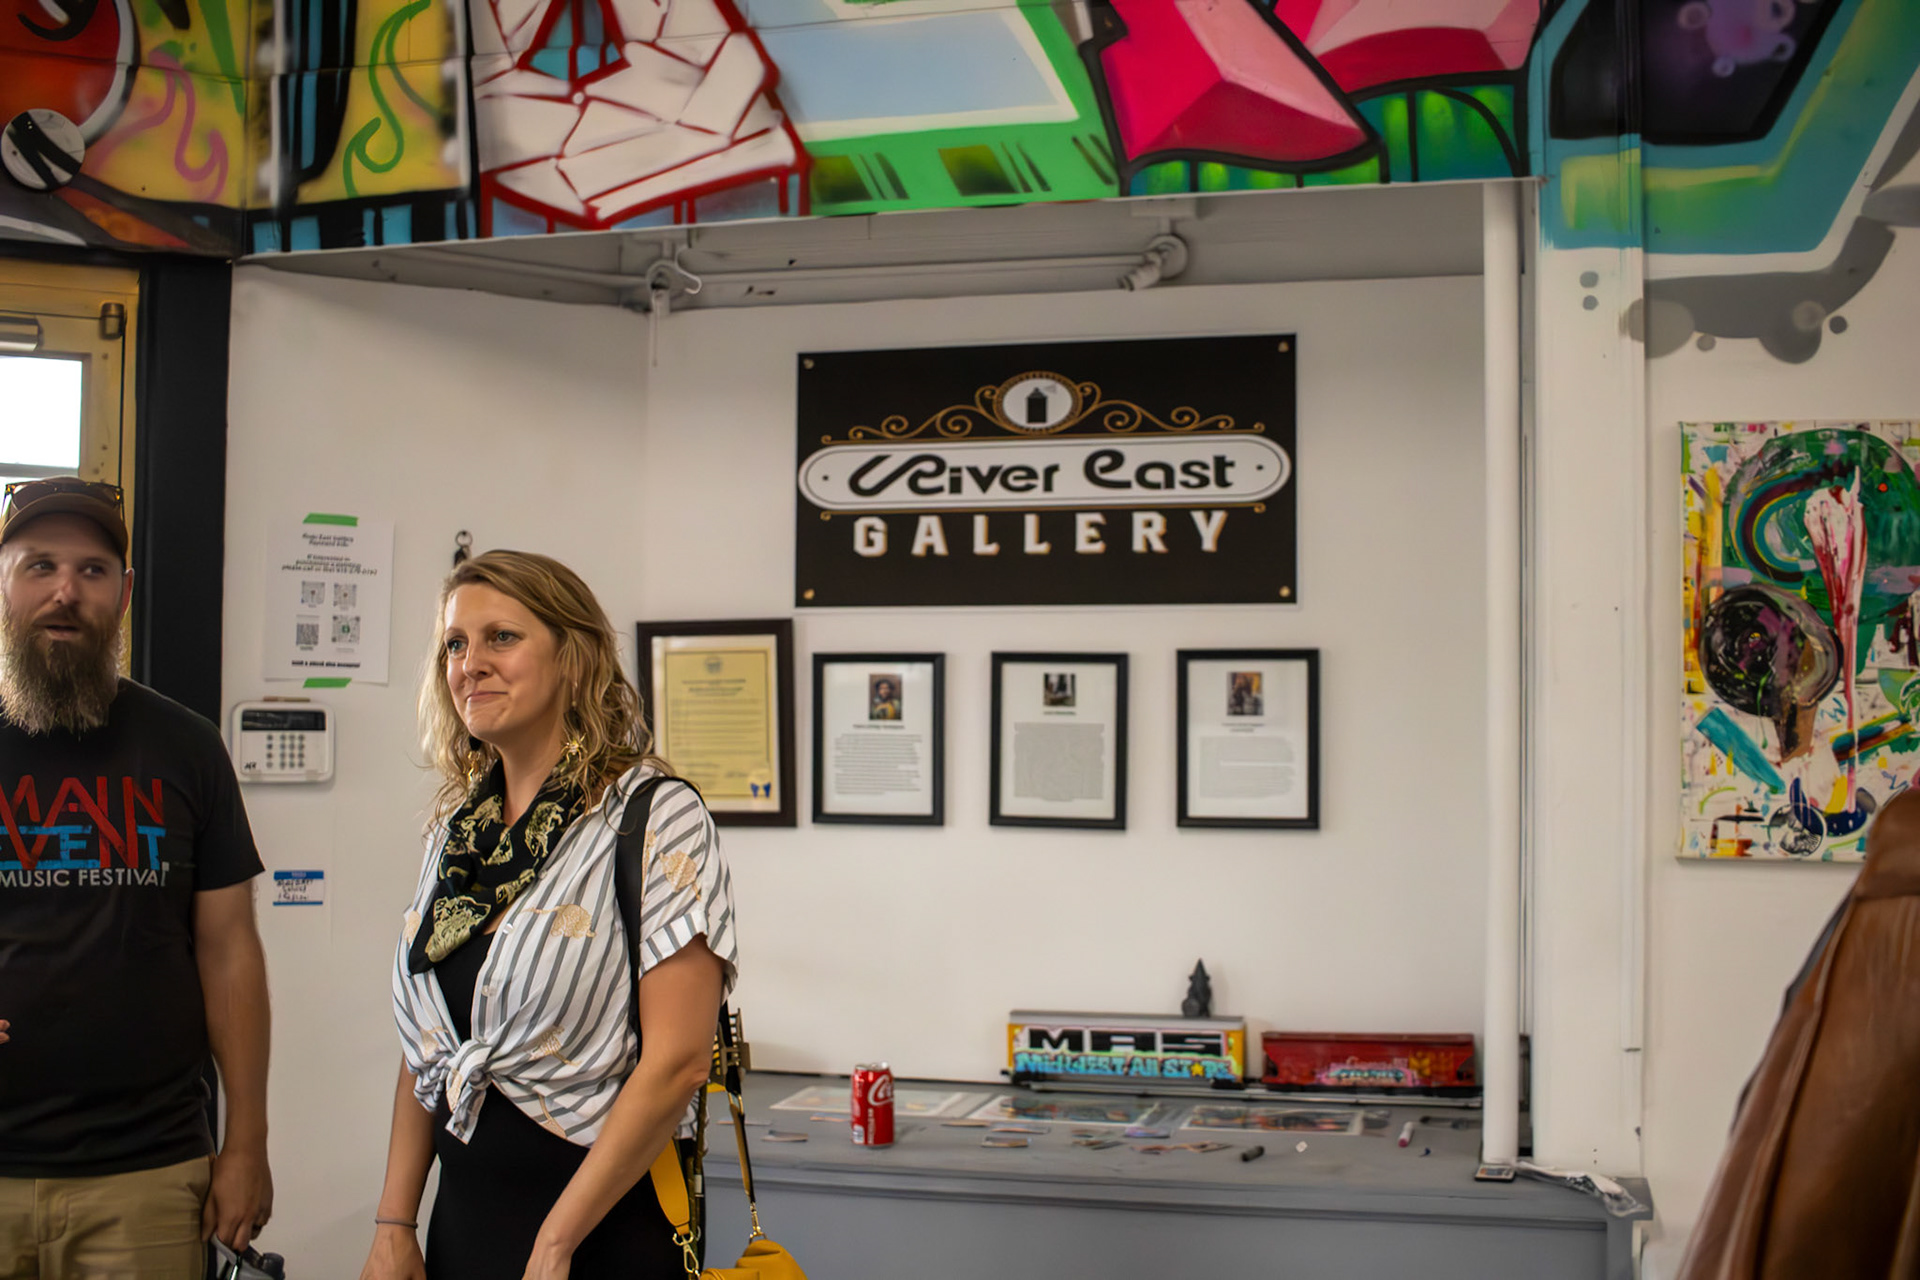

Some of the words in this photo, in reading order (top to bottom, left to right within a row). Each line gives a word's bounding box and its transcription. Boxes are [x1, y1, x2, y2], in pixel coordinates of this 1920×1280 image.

[848, 453, 1059, 497] River
[1083, 448, 1236, 491] East
[853, 511, 1229, 557] GALLERY
[0, 868, 70, 888] MUSIC
